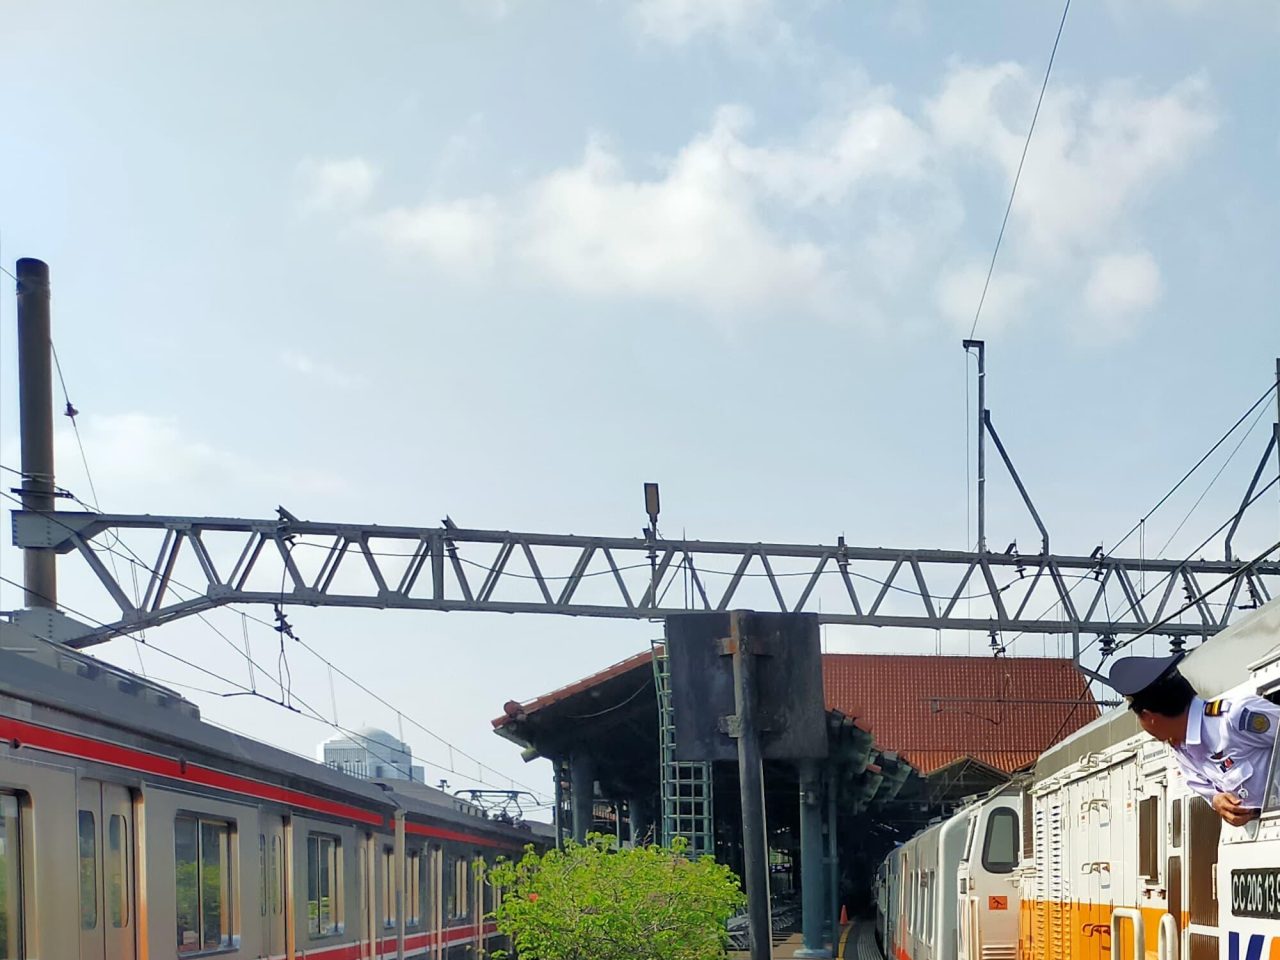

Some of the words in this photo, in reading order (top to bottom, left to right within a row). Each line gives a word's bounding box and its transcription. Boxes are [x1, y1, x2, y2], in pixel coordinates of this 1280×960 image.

[1232, 874, 1246, 911] CC
[1246, 873, 1263, 912] 206
[1264, 873, 1275, 913] 13
